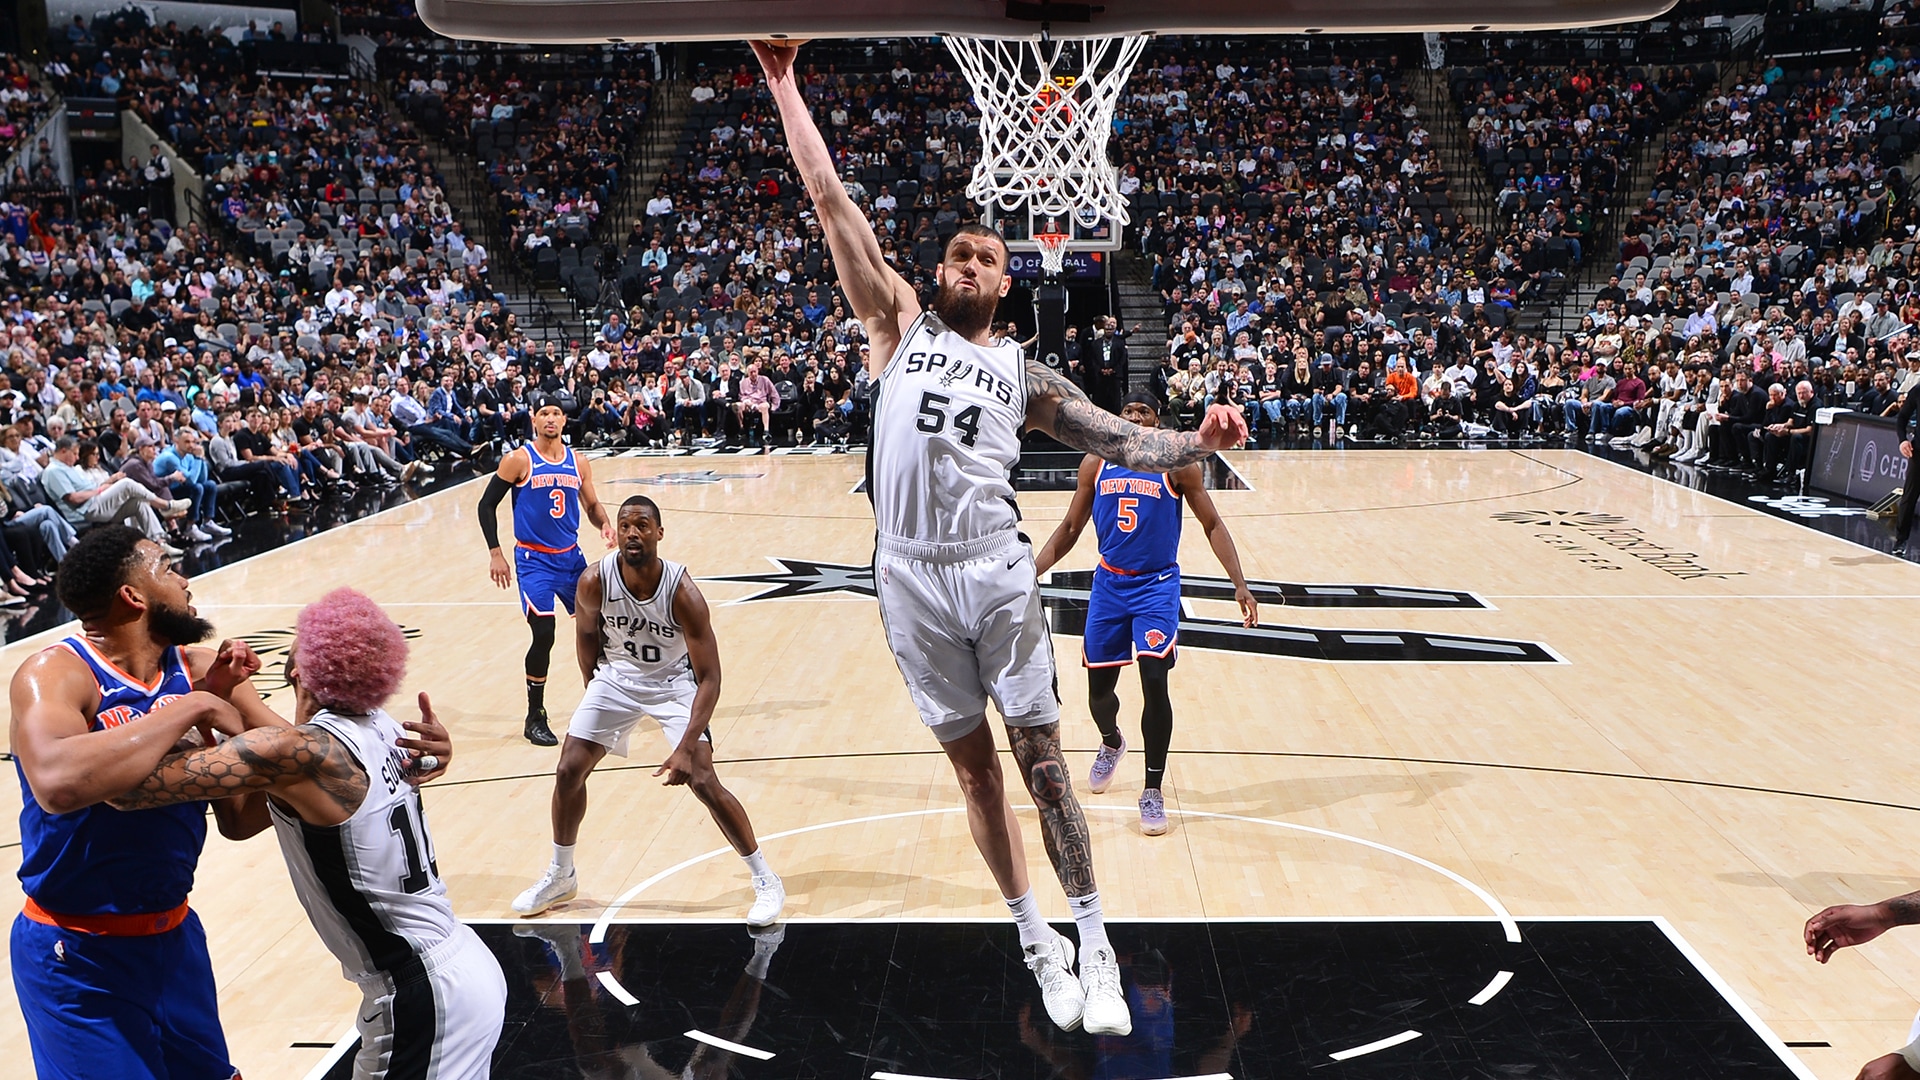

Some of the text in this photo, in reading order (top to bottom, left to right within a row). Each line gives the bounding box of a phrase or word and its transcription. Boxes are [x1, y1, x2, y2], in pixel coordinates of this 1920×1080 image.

[906, 352, 1013, 406] SPURS
[915, 389, 984, 450] 54
[531, 473, 580, 490] NEW YORK
[1100, 478, 1162, 499] NEW YORK
[549, 489, 566, 518] 3
[1117, 497, 1139, 533] 5
[1534, 533, 1624, 571] CENTER
[606, 616, 675, 638] SPURS
[624, 640, 661, 663] 40
